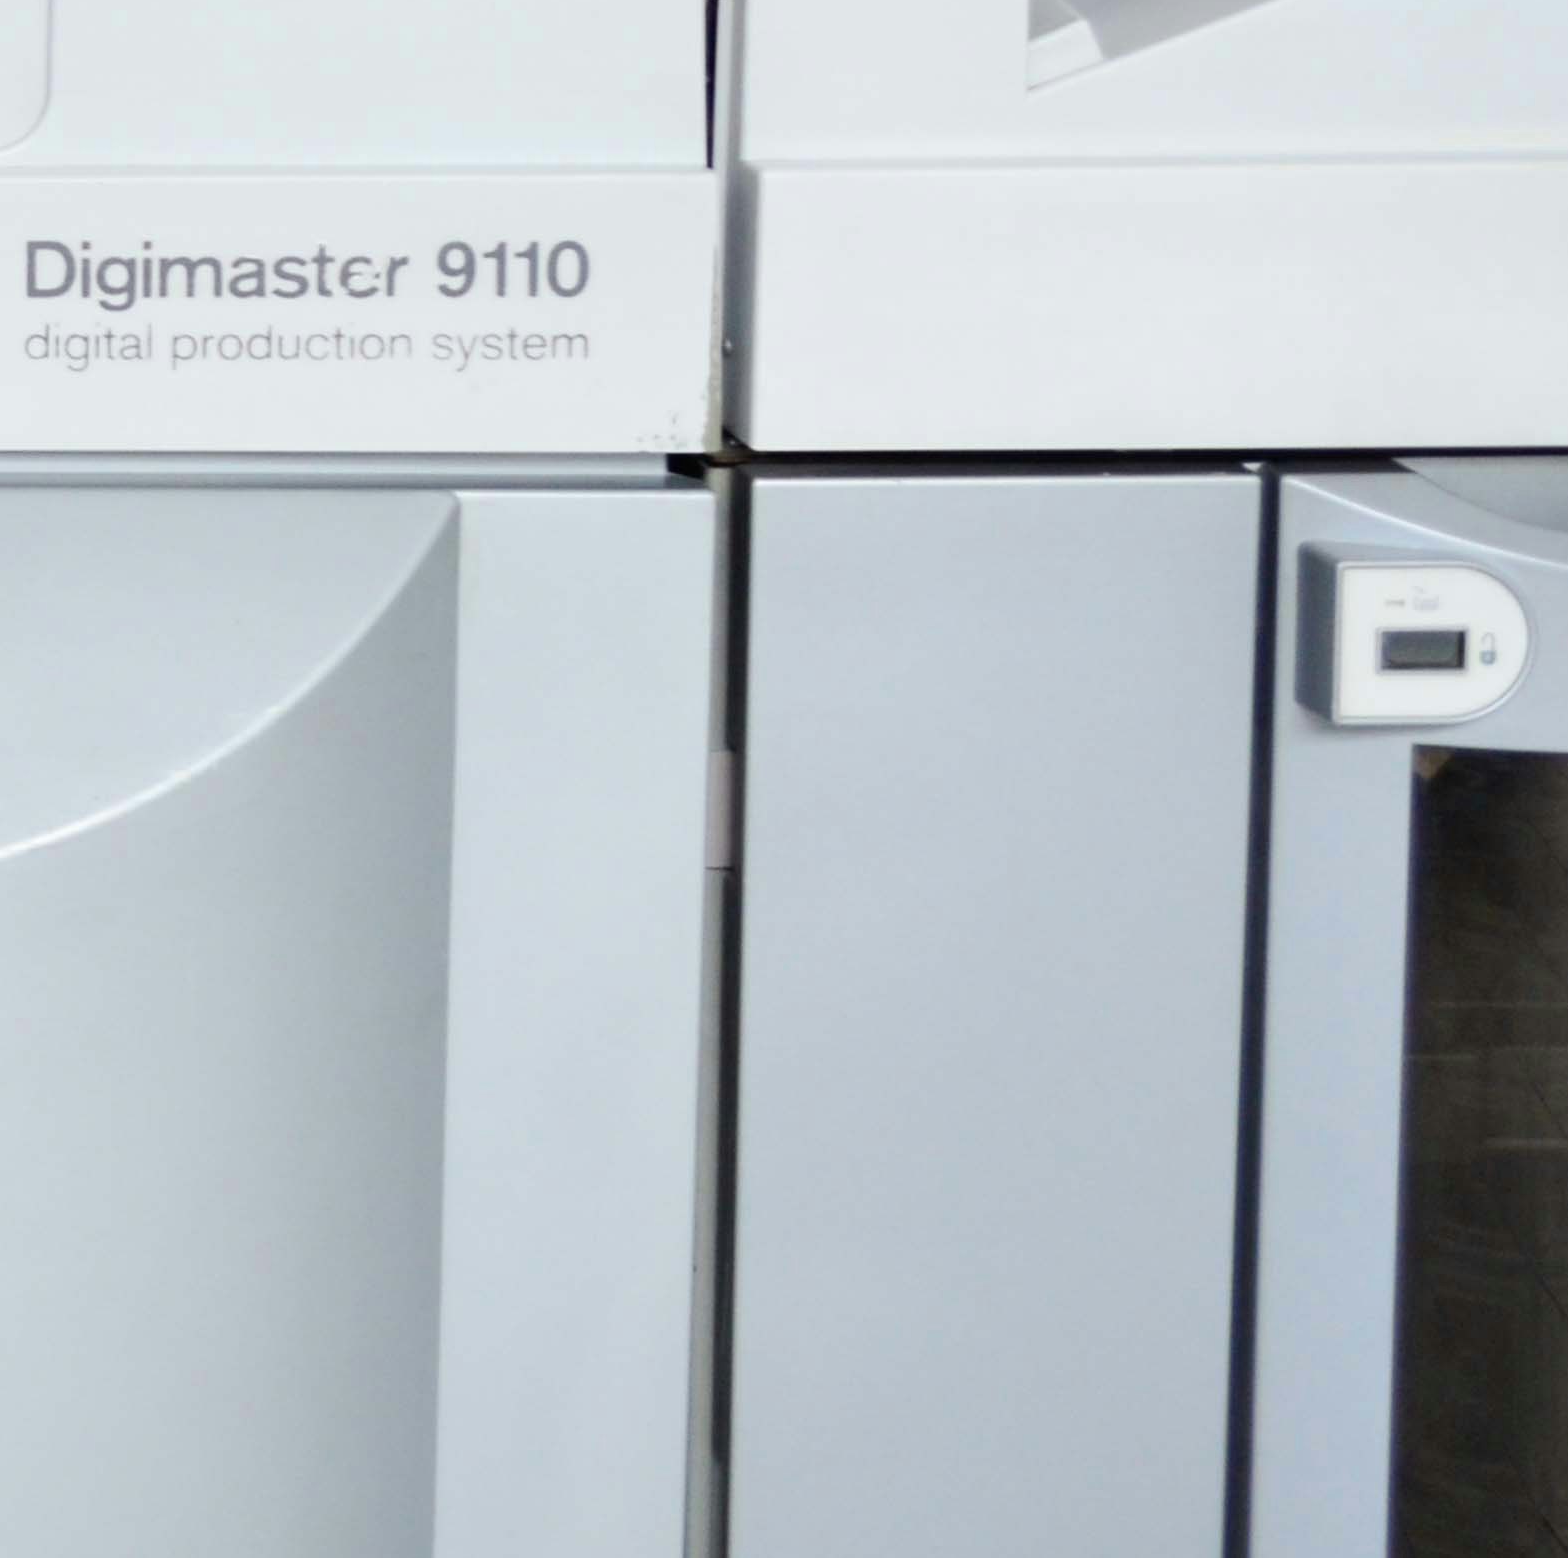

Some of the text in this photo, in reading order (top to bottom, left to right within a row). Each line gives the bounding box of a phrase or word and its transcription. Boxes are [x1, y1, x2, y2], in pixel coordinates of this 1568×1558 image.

[25, 239, 590, 312] Digimaster 9110
[23, 322, 590, 373] digital production system
